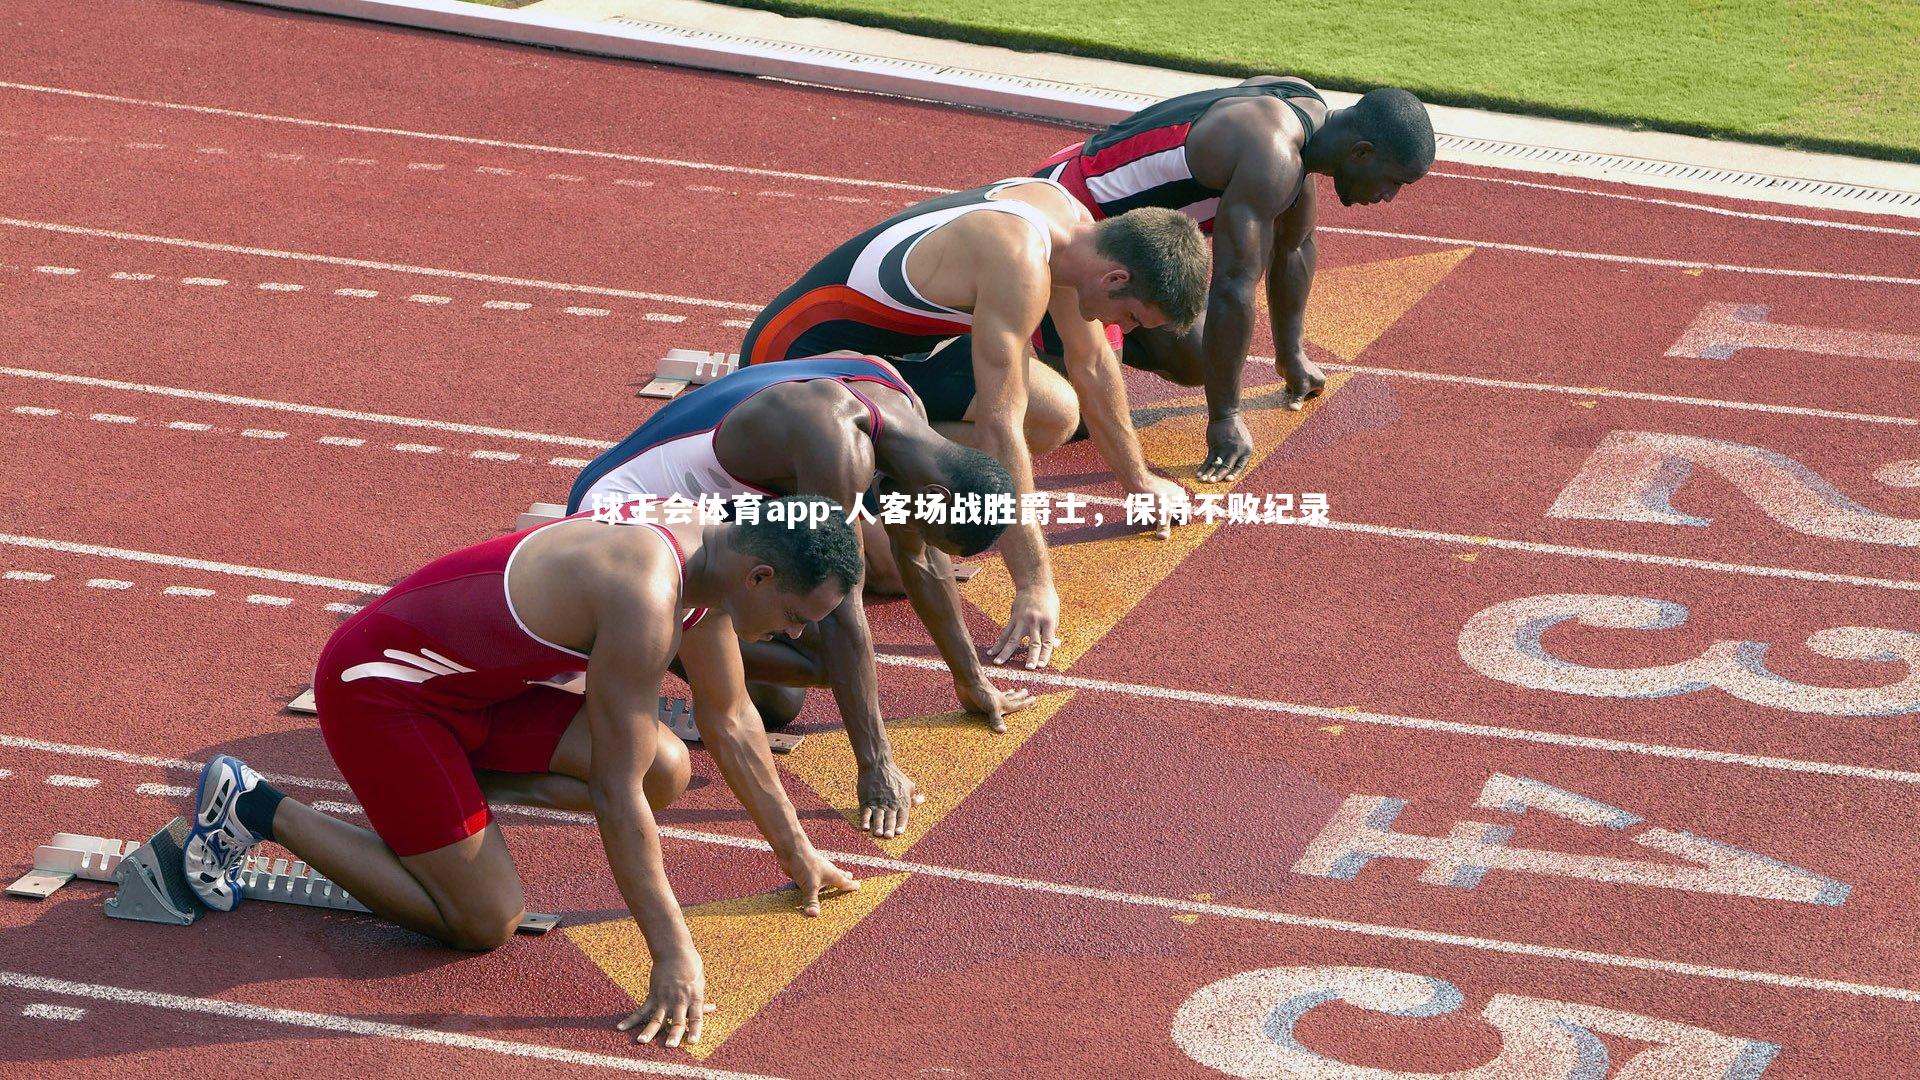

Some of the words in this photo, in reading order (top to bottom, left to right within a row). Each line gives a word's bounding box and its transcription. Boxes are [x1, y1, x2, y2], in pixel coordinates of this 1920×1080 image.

[1546, 429, 1919, 548] 2
[1457, 593, 1919, 717] 3
[1291, 772, 1852, 906] 4
[1170, 965, 1781, 1080] 5
